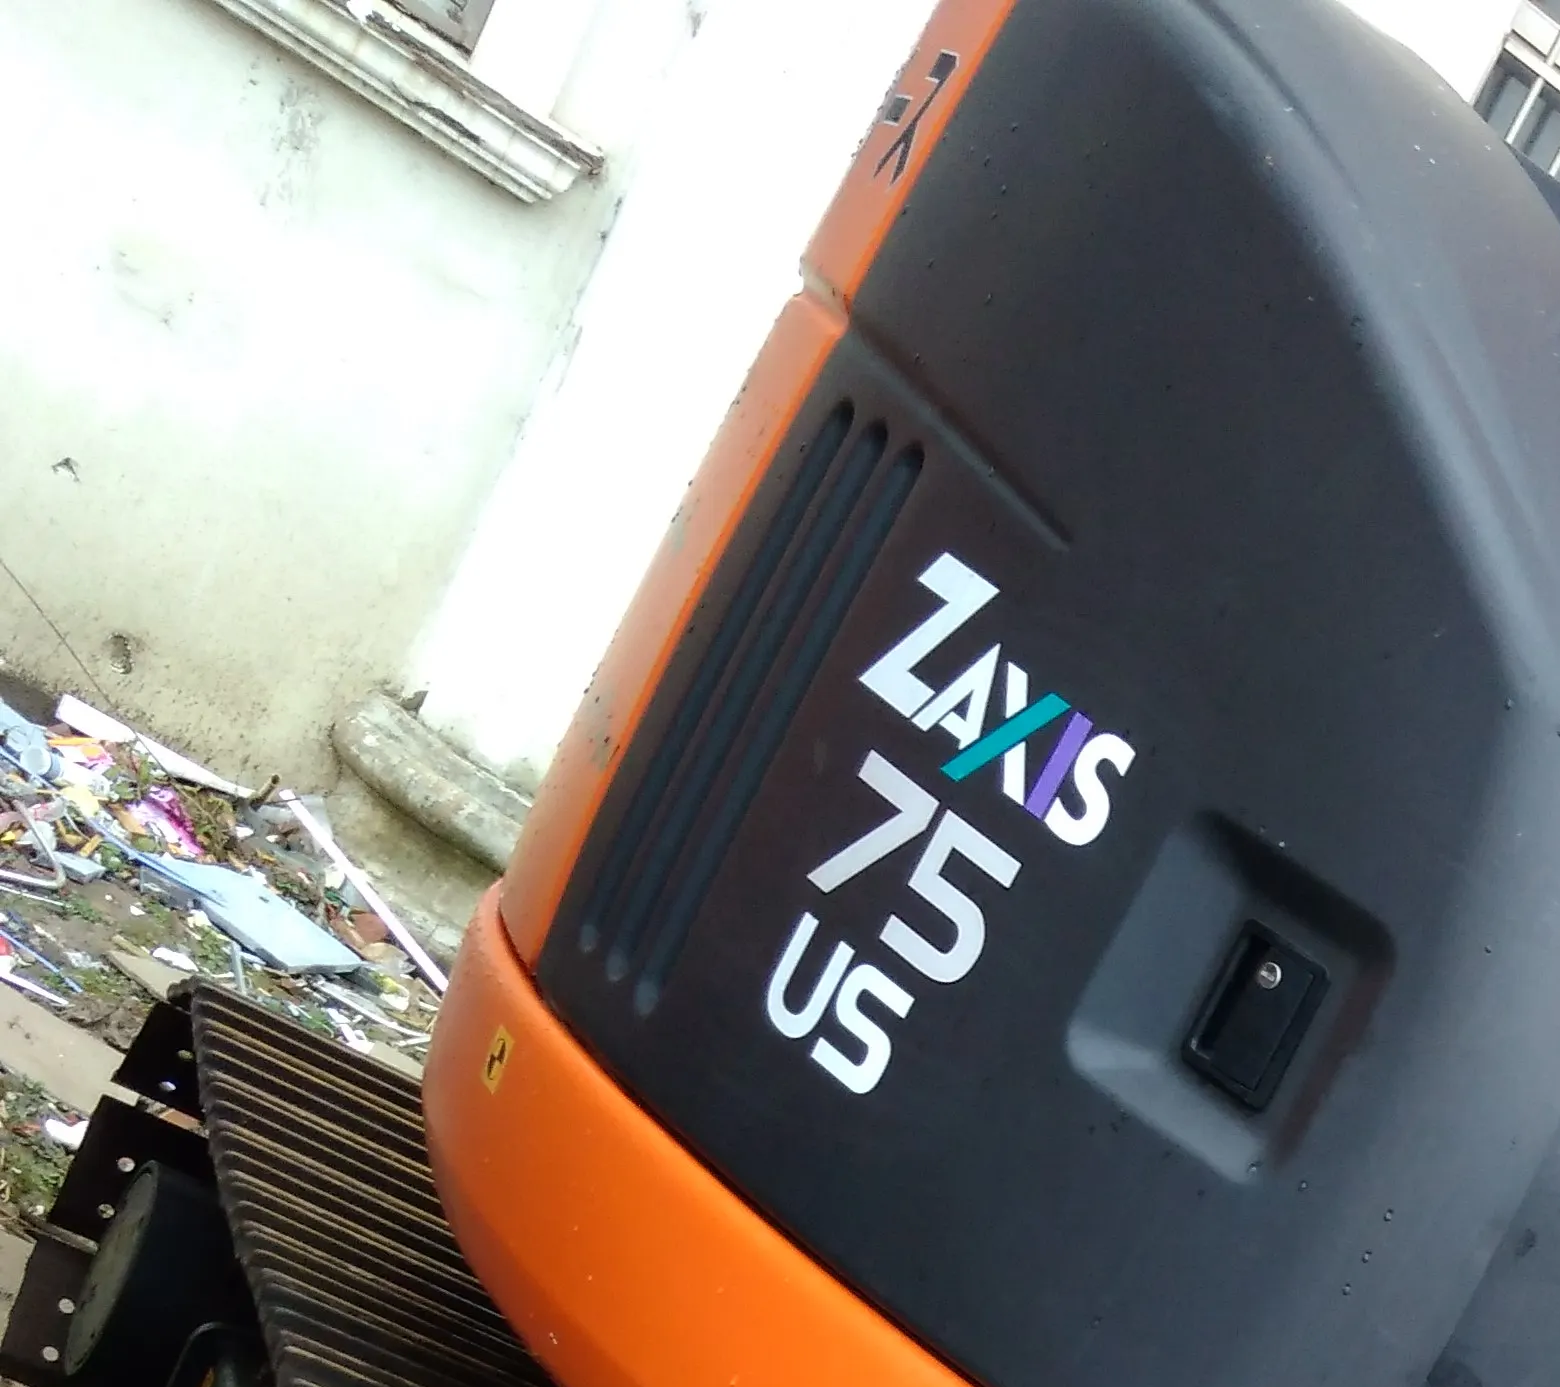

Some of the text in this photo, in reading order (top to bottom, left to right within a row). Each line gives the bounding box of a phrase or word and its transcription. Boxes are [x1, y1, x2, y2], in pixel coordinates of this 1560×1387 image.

[859, 552, 1136, 846] ZAXIS
[806, 749, 1022, 983] 75
[767, 911, 915, 1094] US
